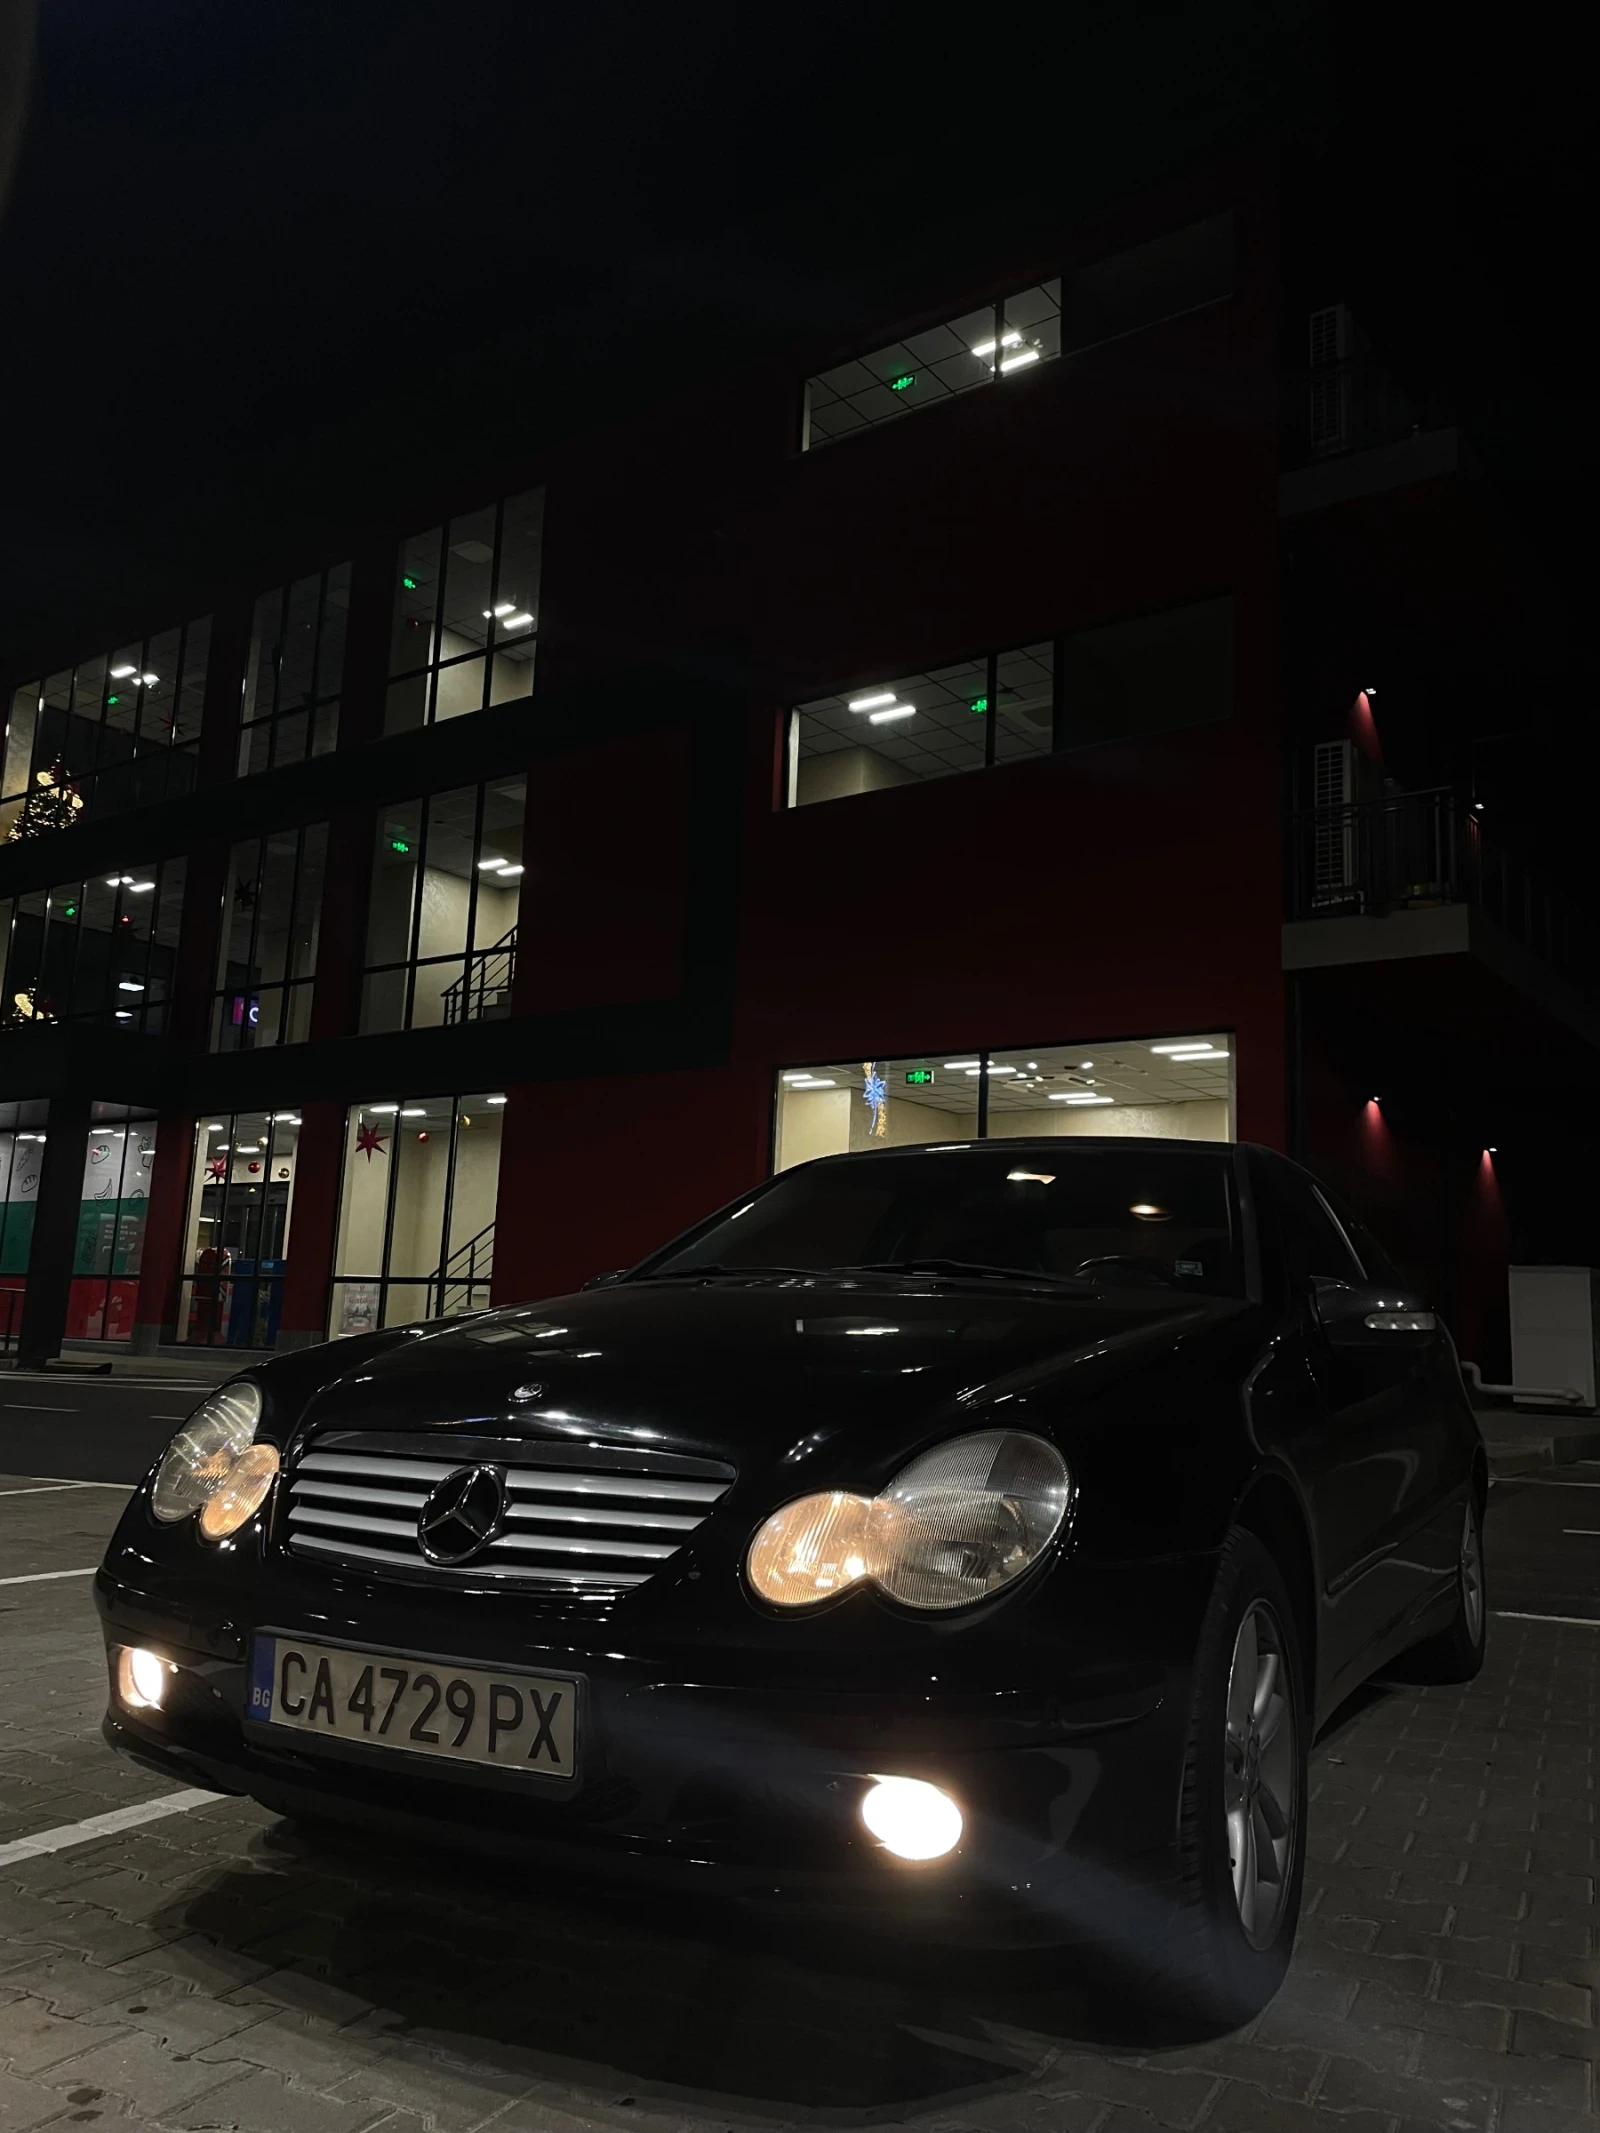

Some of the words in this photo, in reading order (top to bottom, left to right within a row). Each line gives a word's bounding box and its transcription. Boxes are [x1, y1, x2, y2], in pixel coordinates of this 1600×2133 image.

[252, 1687, 271, 1708] BG
[280, 1651, 335, 1725] CA
[347, 1665, 477, 1748] 4729
[488, 1683, 563, 1764] PX
